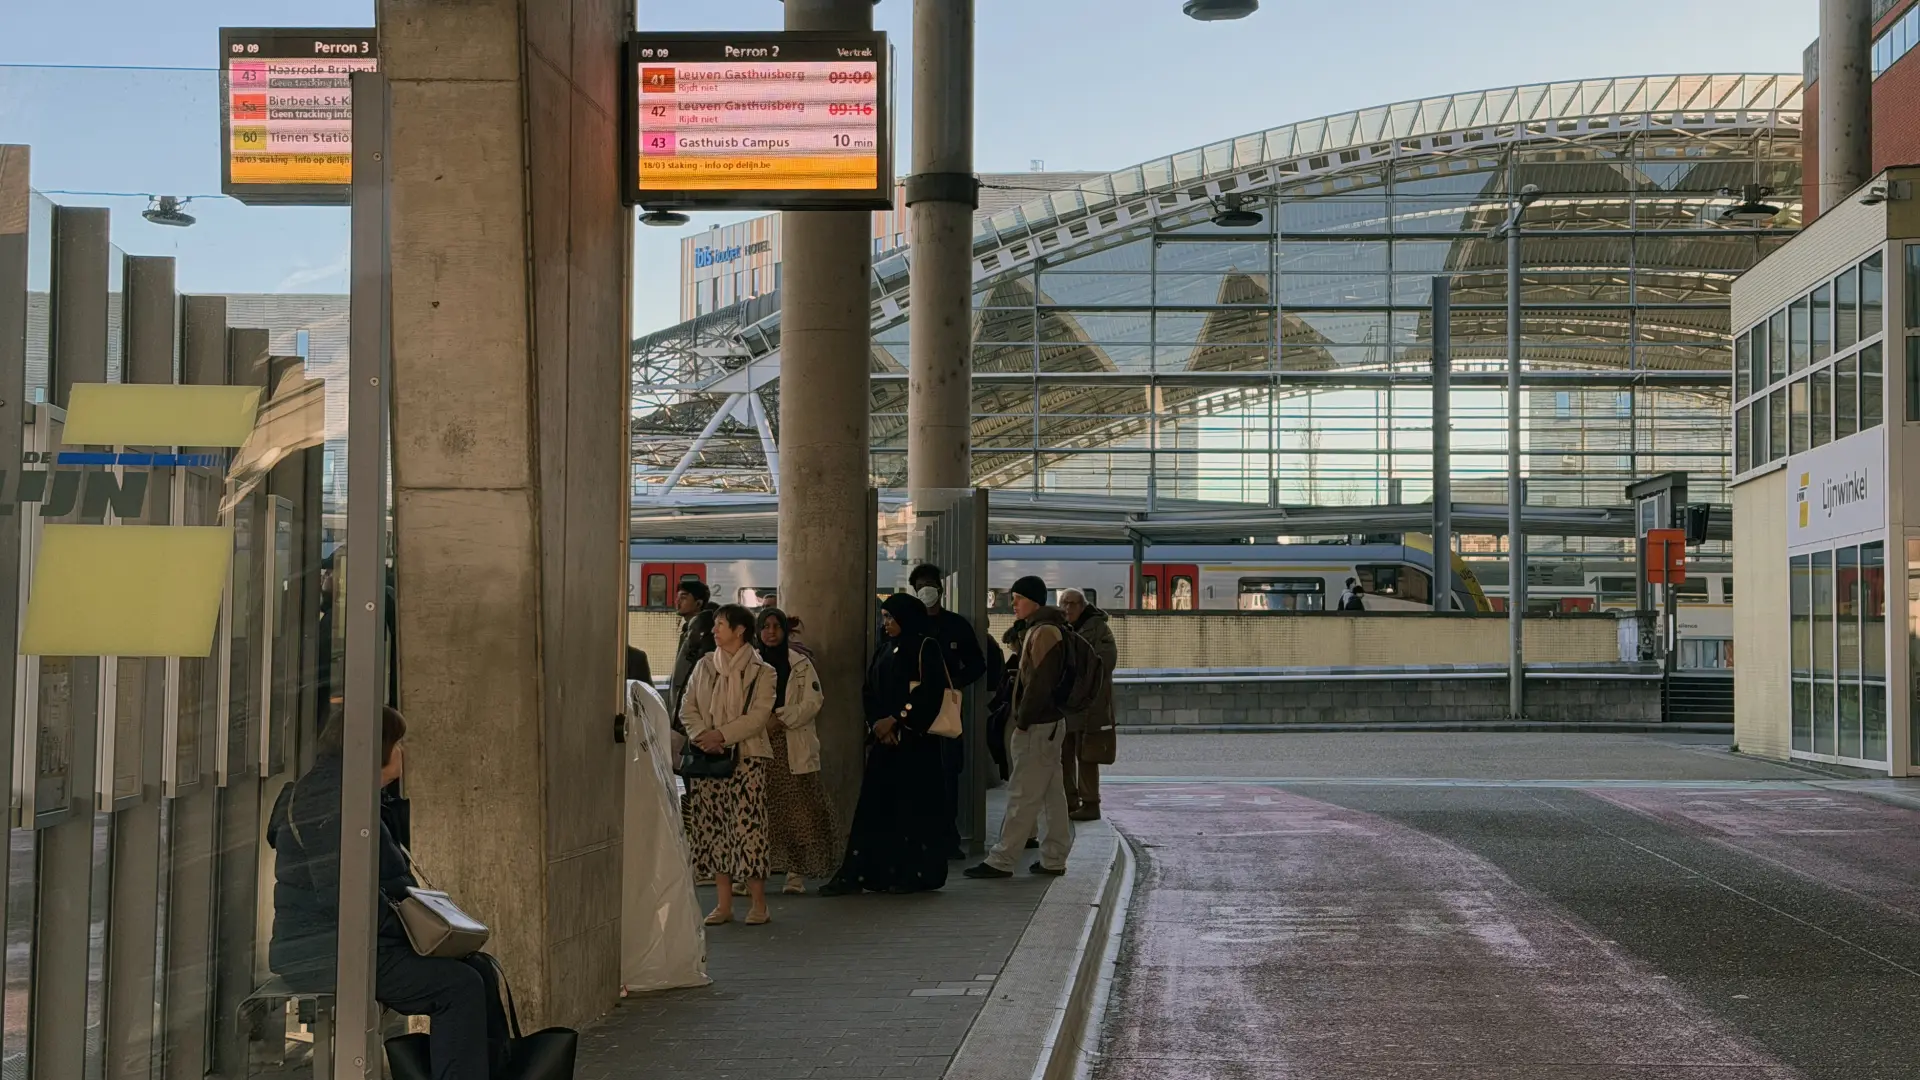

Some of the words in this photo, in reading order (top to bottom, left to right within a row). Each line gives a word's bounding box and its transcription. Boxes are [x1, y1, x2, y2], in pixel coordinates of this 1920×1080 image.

[232, 44, 244, 53] 09
[247, 44, 259, 53] 09
[314, 41, 357, 53] Perron
[362, 42, 369, 53] 3
[725, 46, 768, 57] Perron
[772, 46, 779, 57] 2
[837, 48, 872, 56] Vertrek
[642, 49, 653, 57] 09
[657, 49, 669, 57] 09
[269, 65, 324, 74] Haasrode
[678, 69, 720, 80] Leuven
[725, 69, 805, 81] Gasthuisberg
[242, 70, 257, 81] 43
[651, 74, 665, 86] 41
[829, 71, 872, 84] 09:09
[271, 79, 292, 87] Geen
[679, 83, 698, 93] Rijdt
[269, 96, 320, 106] Bierbeek
[324, 96, 350, 106] St-K
[678, 101, 720, 111] Leuven
[725, 100, 805, 112] Gasthuisberg
[651, 106, 666, 117] 42
[829, 103, 872, 116] 09:16
[296, 111, 332, 120] tracking
[679, 116, 698, 124] Rijdt
[243, 131, 257, 142] 60
[271, 132, 309, 142] Tienen
[314, 132, 352, 142] Statio
[833, 134, 850, 147] 10
[854, 138, 873, 147] min
[651, 138, 666, 148] 43
[679, 137, 738, 148] Gasthuisb
[742, 138, 790, 149] Campus
[259, 156, 288, 165] staking
[295, 155, 311, 163] info
[313, 157, 325, 165] op
[326, 156, 350, 165] delijn
[644, 161, 666, 169] 18/03
[668, 161, 698, 171] staking
[705, 161, 721, 169] info
[723, 162, 733, 170] op
[736, 161, 771, 170] delijn.be
[695, 246, 713, 268] ibis
[745, 240, 771, 256] HOTEL
[23, 452, 52, 463] DE
[1822, 467, 1868, 518] Lijnwinkel
[712, 584, 722, 597] 2
[1114, 585, 1124, 598] 2
[1206, 585, 1214, 599] 1
